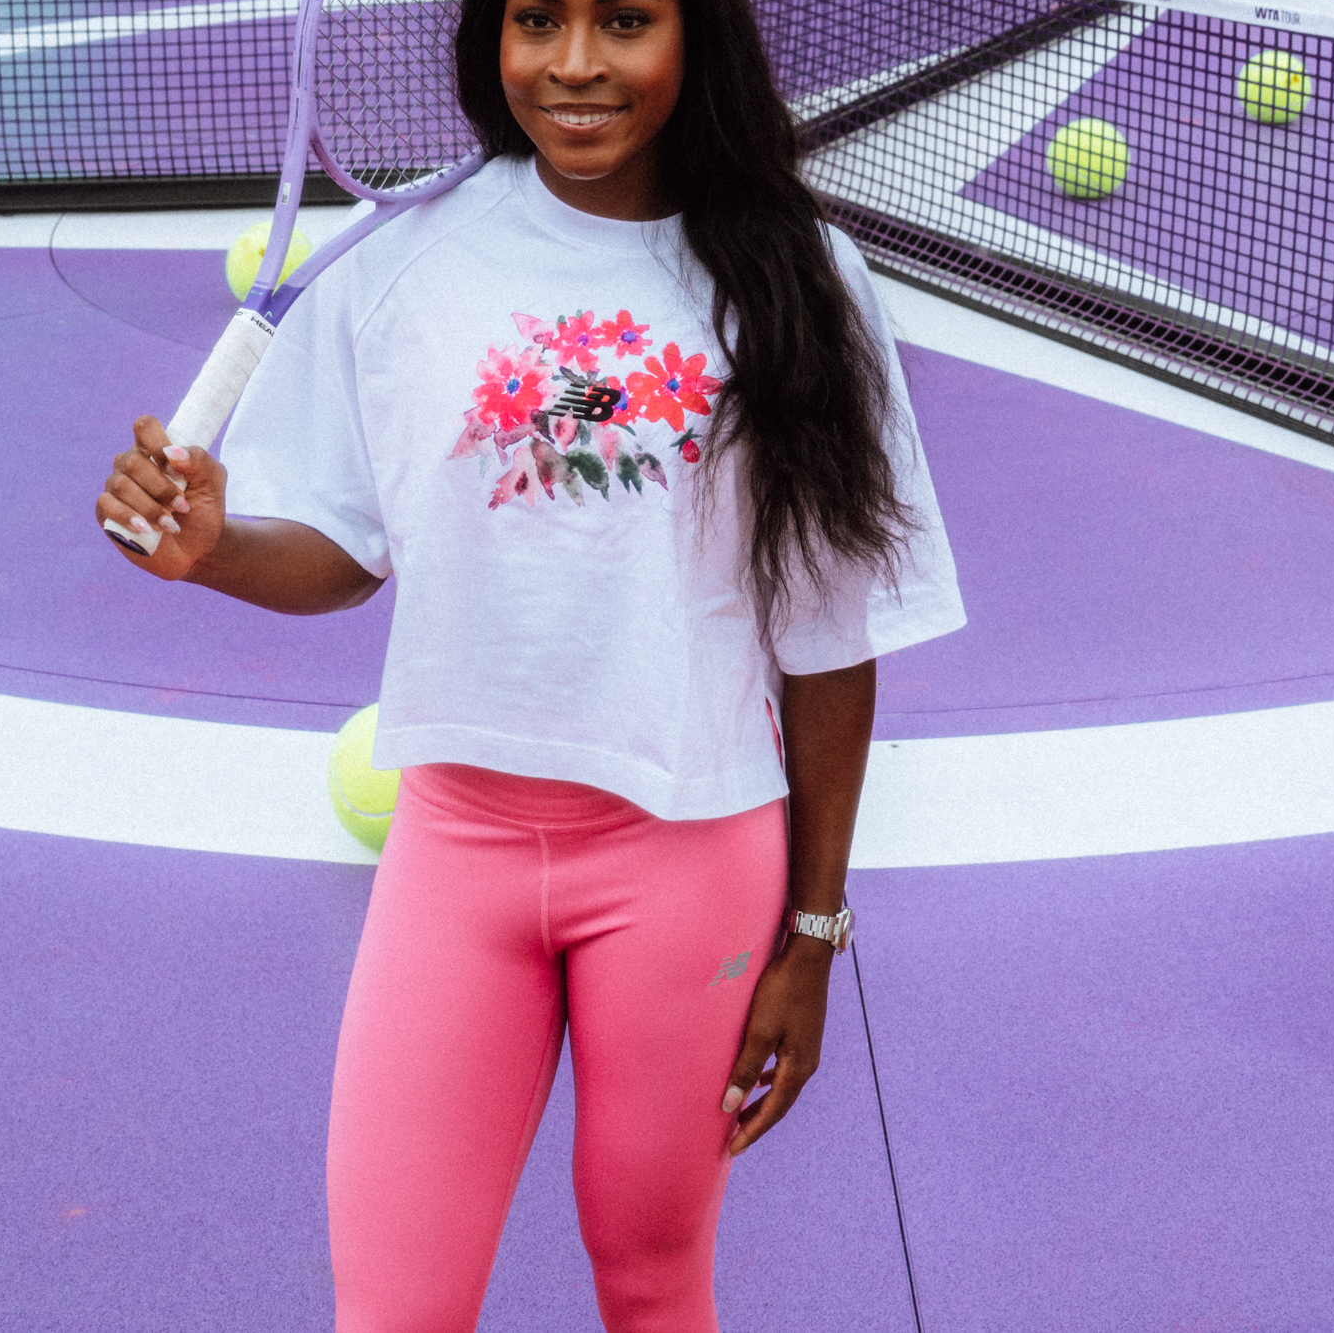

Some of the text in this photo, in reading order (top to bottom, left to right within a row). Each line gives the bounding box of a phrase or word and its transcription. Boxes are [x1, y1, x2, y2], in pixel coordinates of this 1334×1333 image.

[1255, 6, 1301, 26] WTA TOUR
[250, 316, 275, 337] HEA
